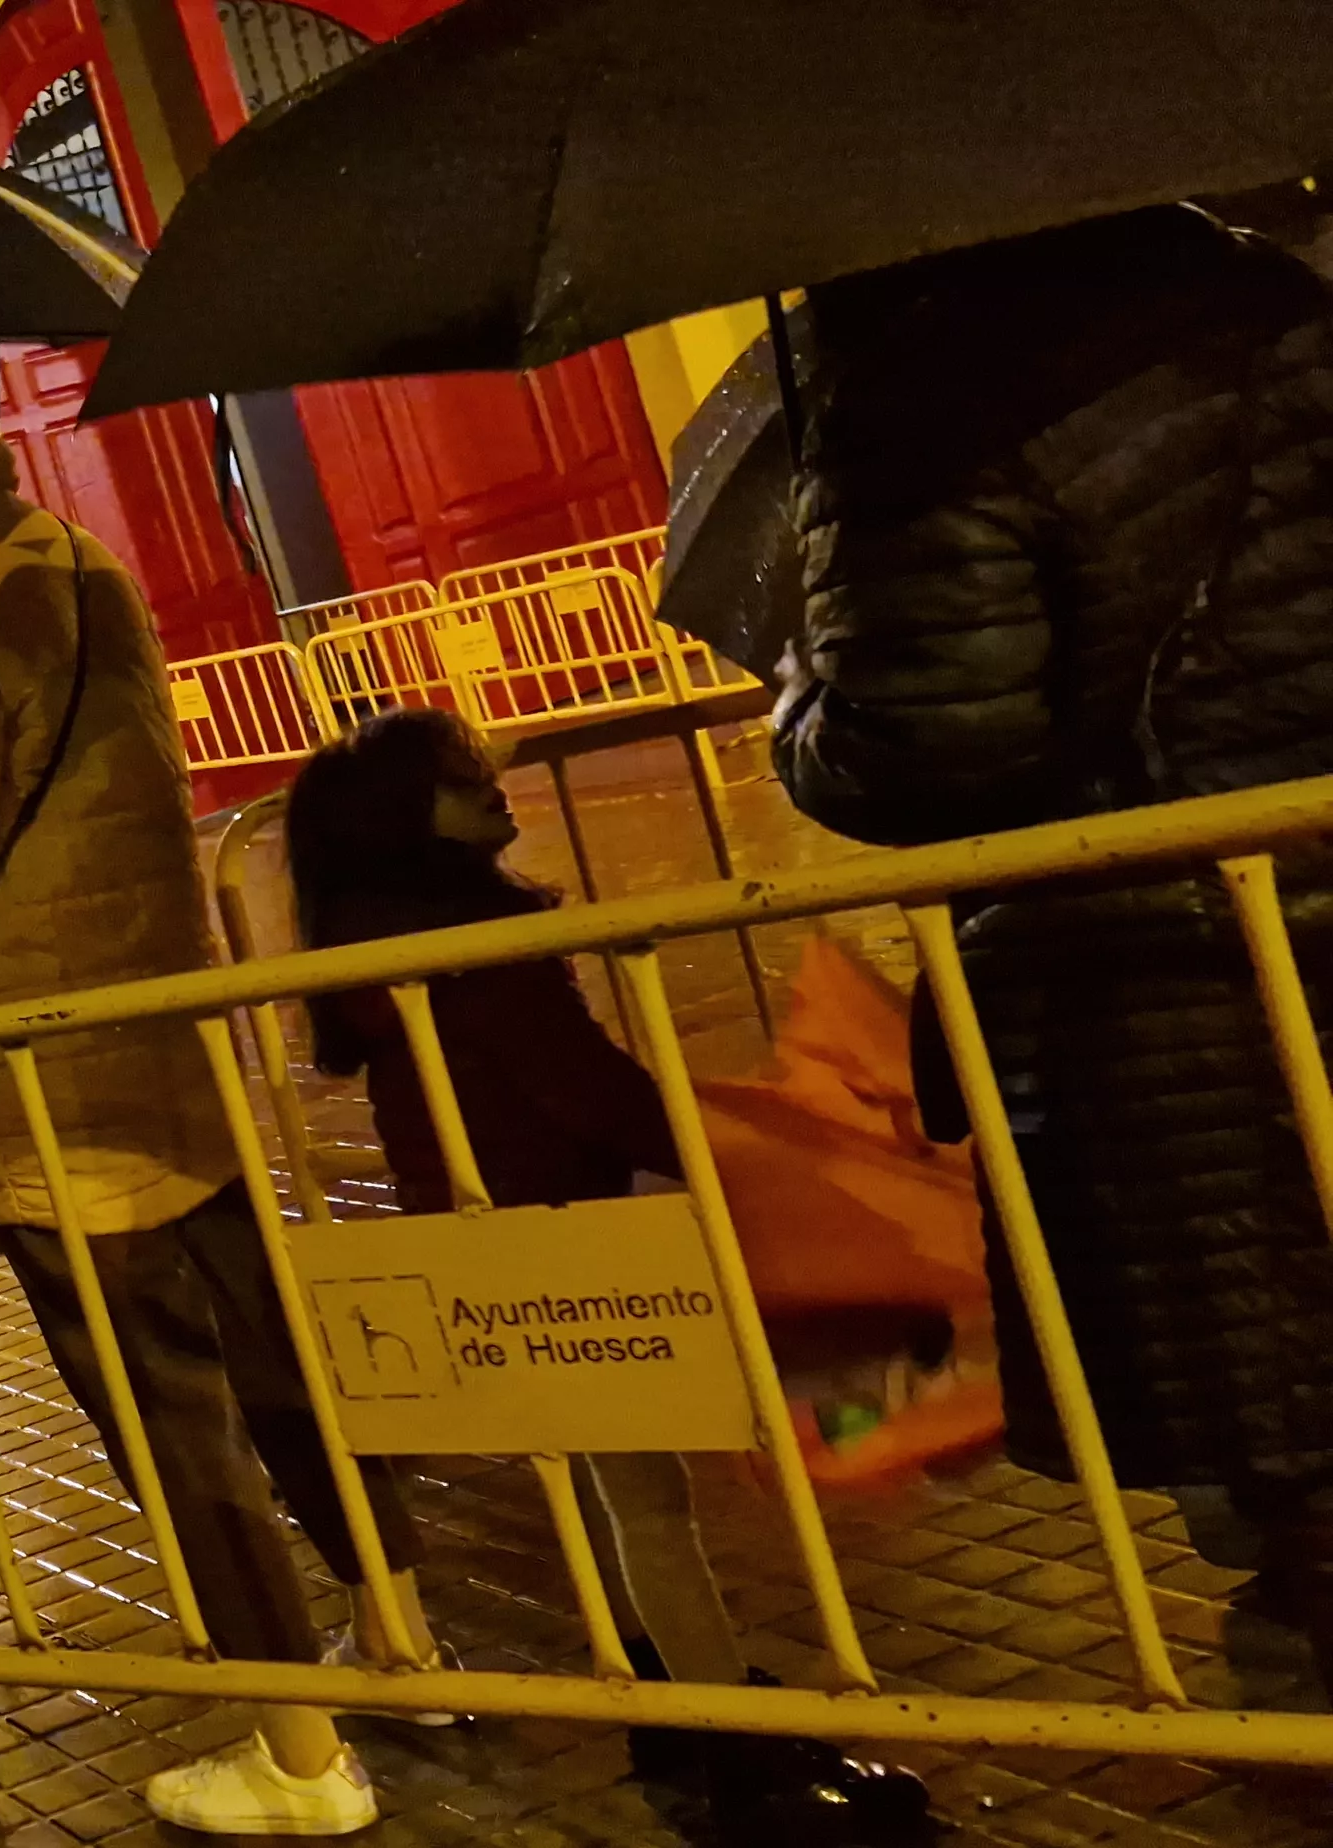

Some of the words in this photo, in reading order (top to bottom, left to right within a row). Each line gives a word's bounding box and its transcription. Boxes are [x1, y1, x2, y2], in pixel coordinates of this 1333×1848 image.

[451, 1286, 713, 1335] Ayuntamiento
[459, 1337, 508, 1367] de
[523, 1333, 675, 1367] Huesca
